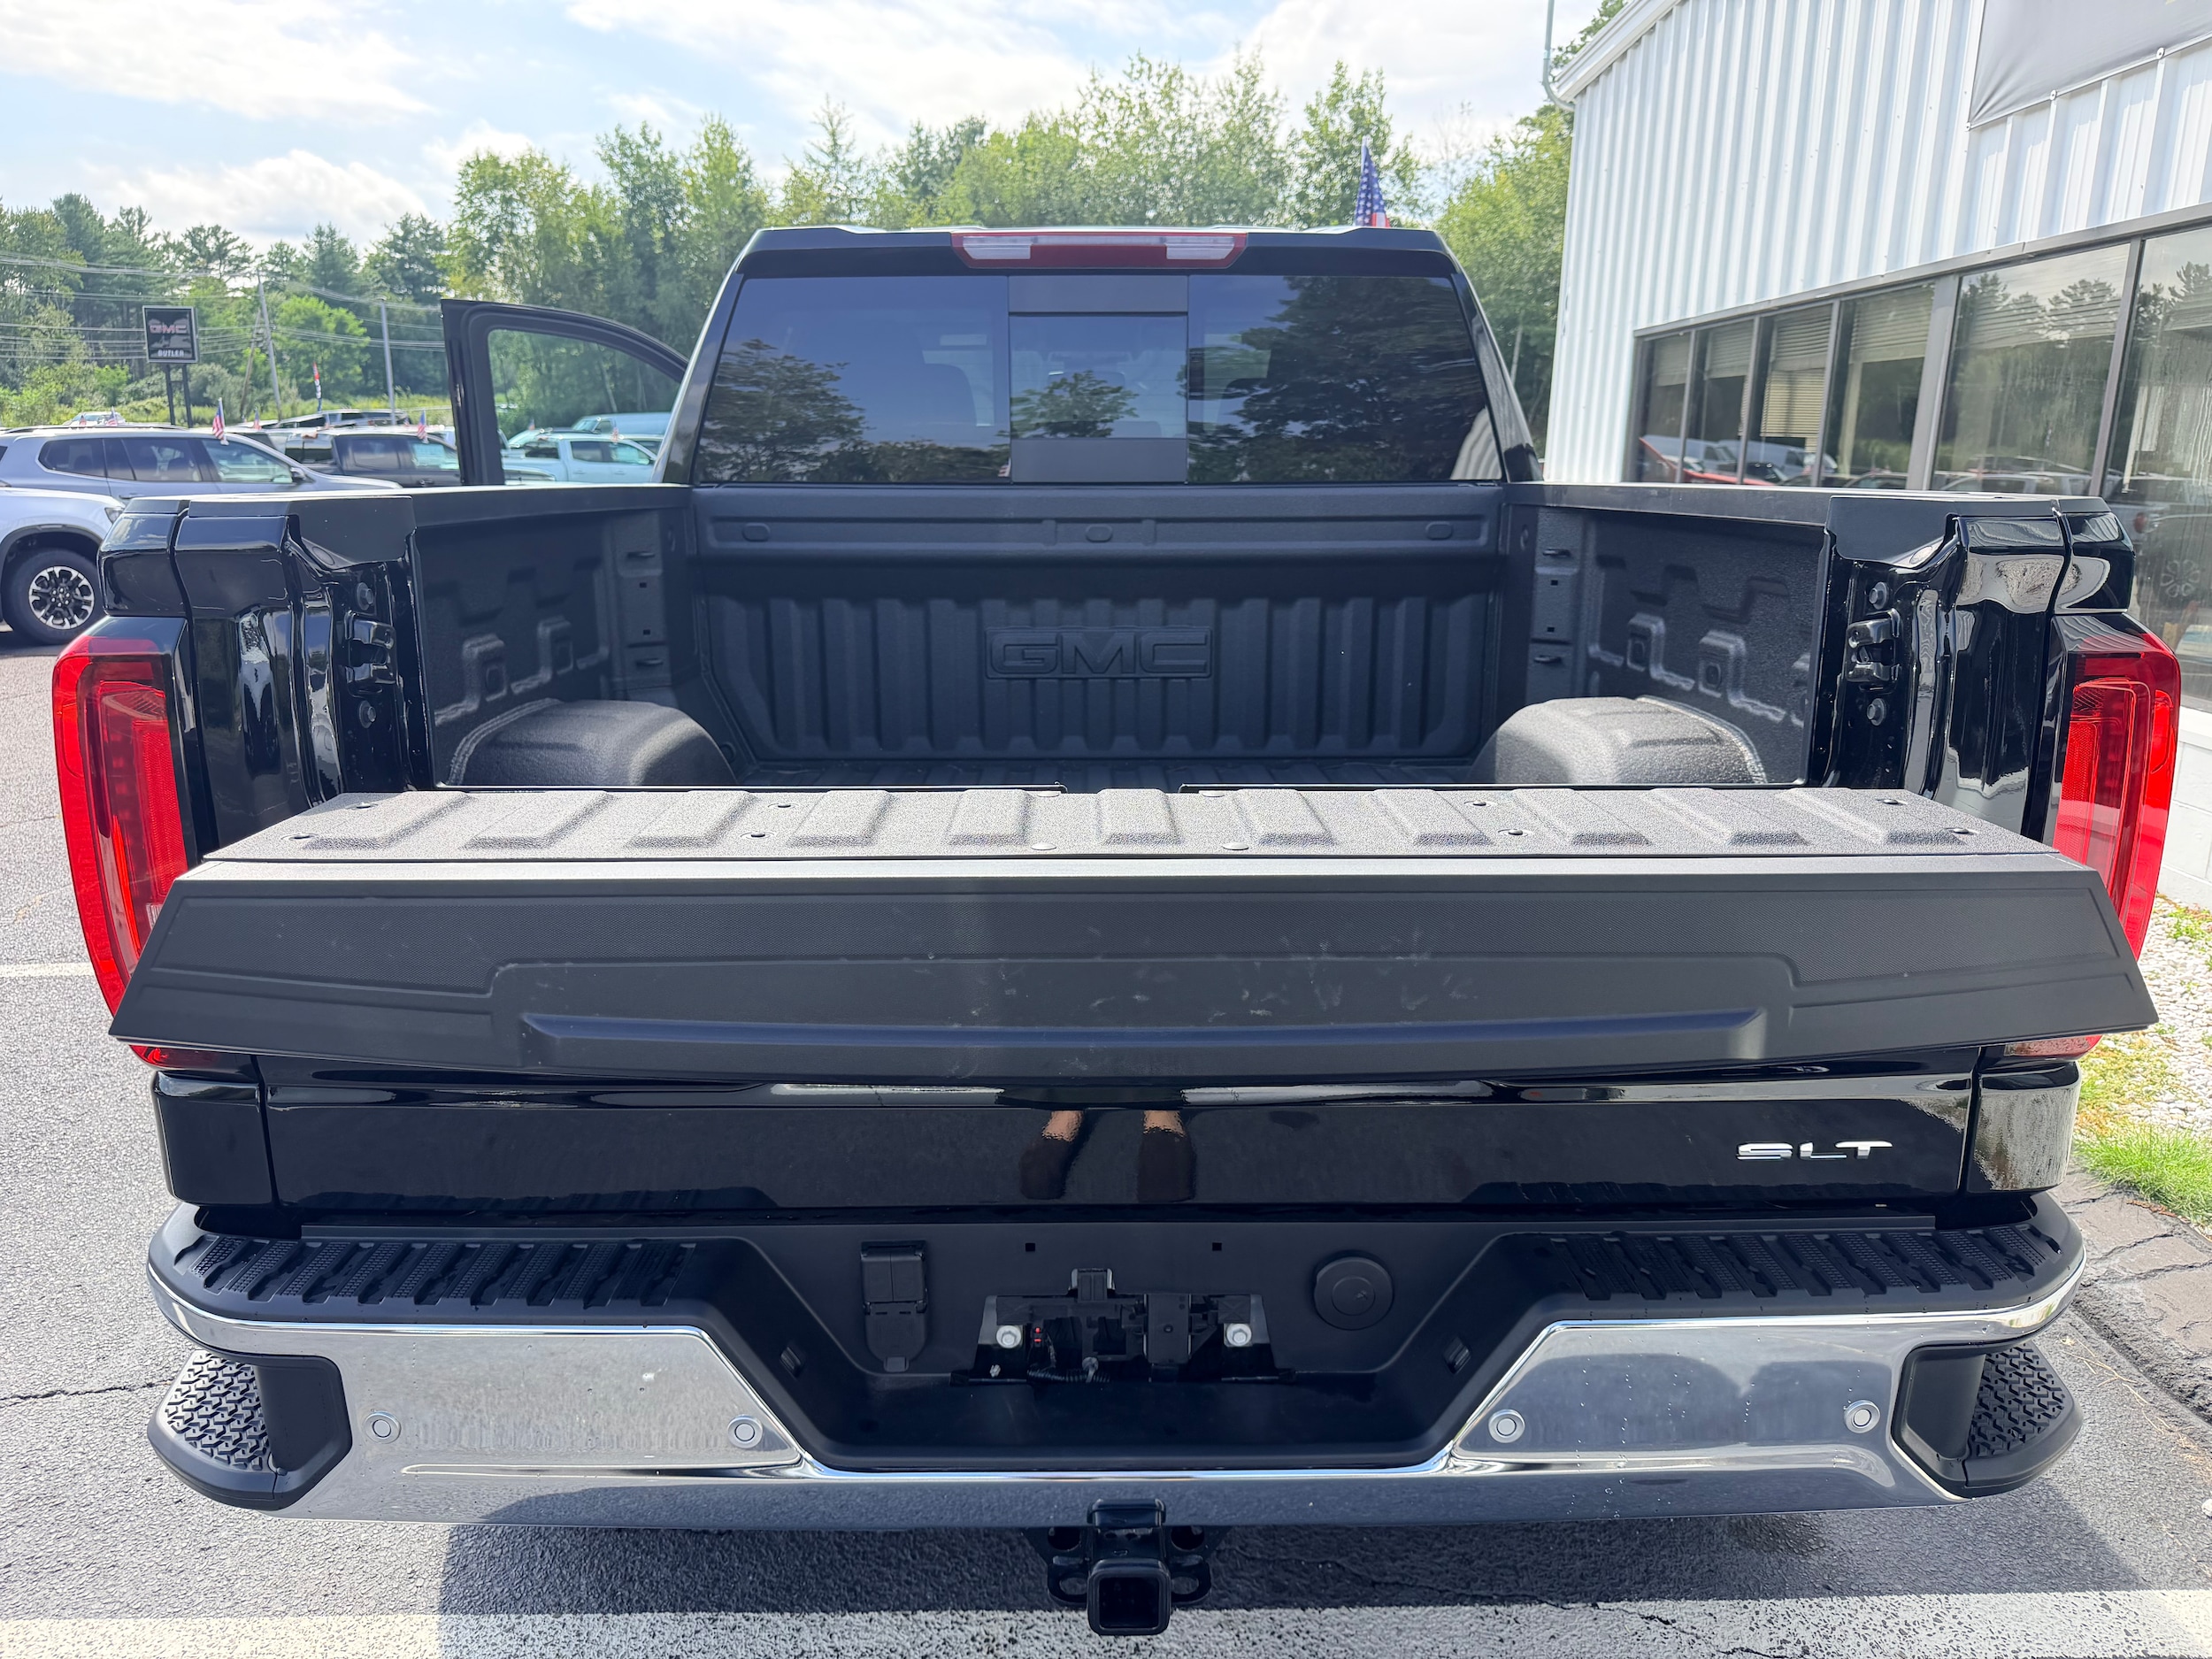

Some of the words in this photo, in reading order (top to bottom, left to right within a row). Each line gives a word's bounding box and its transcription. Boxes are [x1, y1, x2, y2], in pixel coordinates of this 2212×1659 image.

[157, 349, 184, 357] BUTLER
[991, 632, 1208, 675] GMC
[1736, 1140, 1893, 1161] SLT
